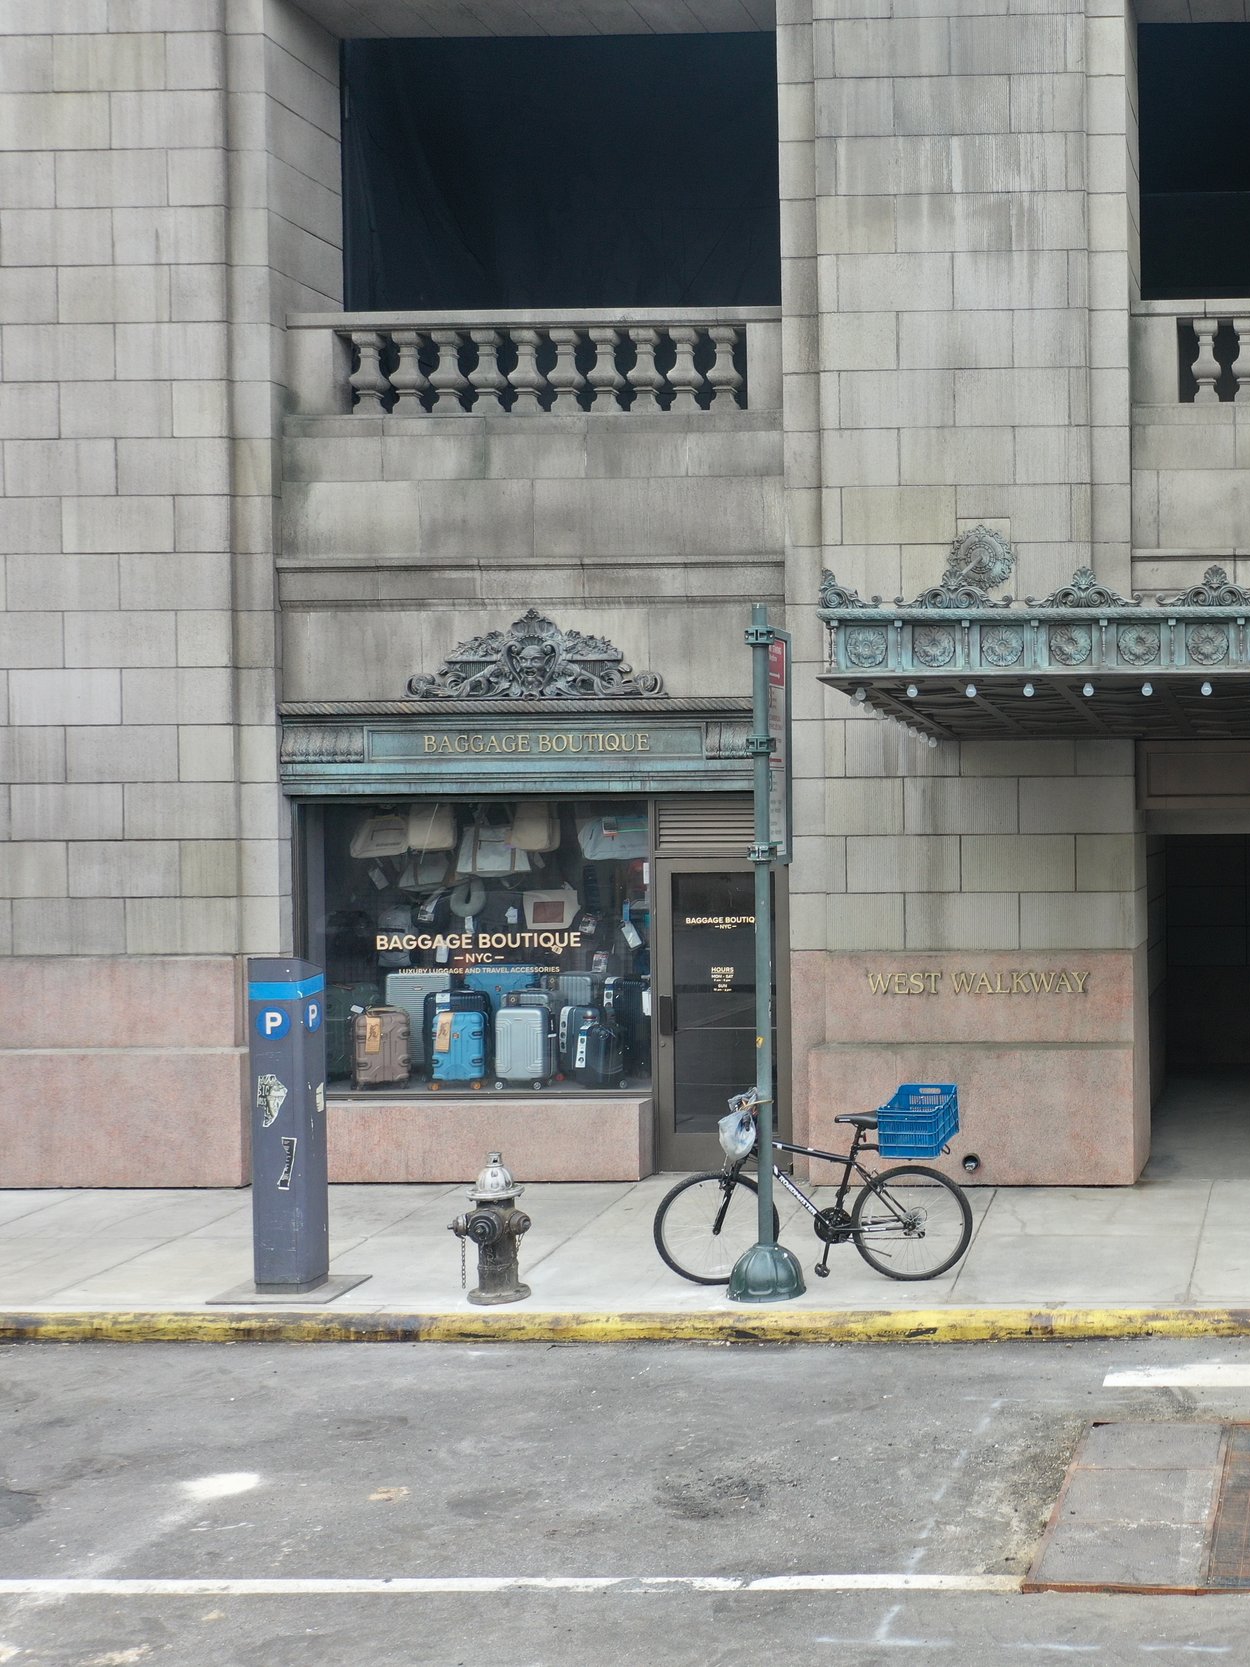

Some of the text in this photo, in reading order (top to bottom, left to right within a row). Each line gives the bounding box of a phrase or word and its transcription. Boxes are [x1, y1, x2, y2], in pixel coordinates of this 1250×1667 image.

[423, 732, 651, 754] BAGGAGE BOUTIQUE
[725, 916, 755, 924] BOUTIQ
[375, 932, 582, 954] BAGGAGE BOUTIQUE
[466, 952, 492, 963] NYC
[398, 967, 428, 975] LUXURY
[867, 971, 1090, 996] WEST WALKWAY
[264, 1012, 283, 1035] P
[308, 1004, 318, 1028] P
[778, 1175, 818, 1216] ROADMASTER
